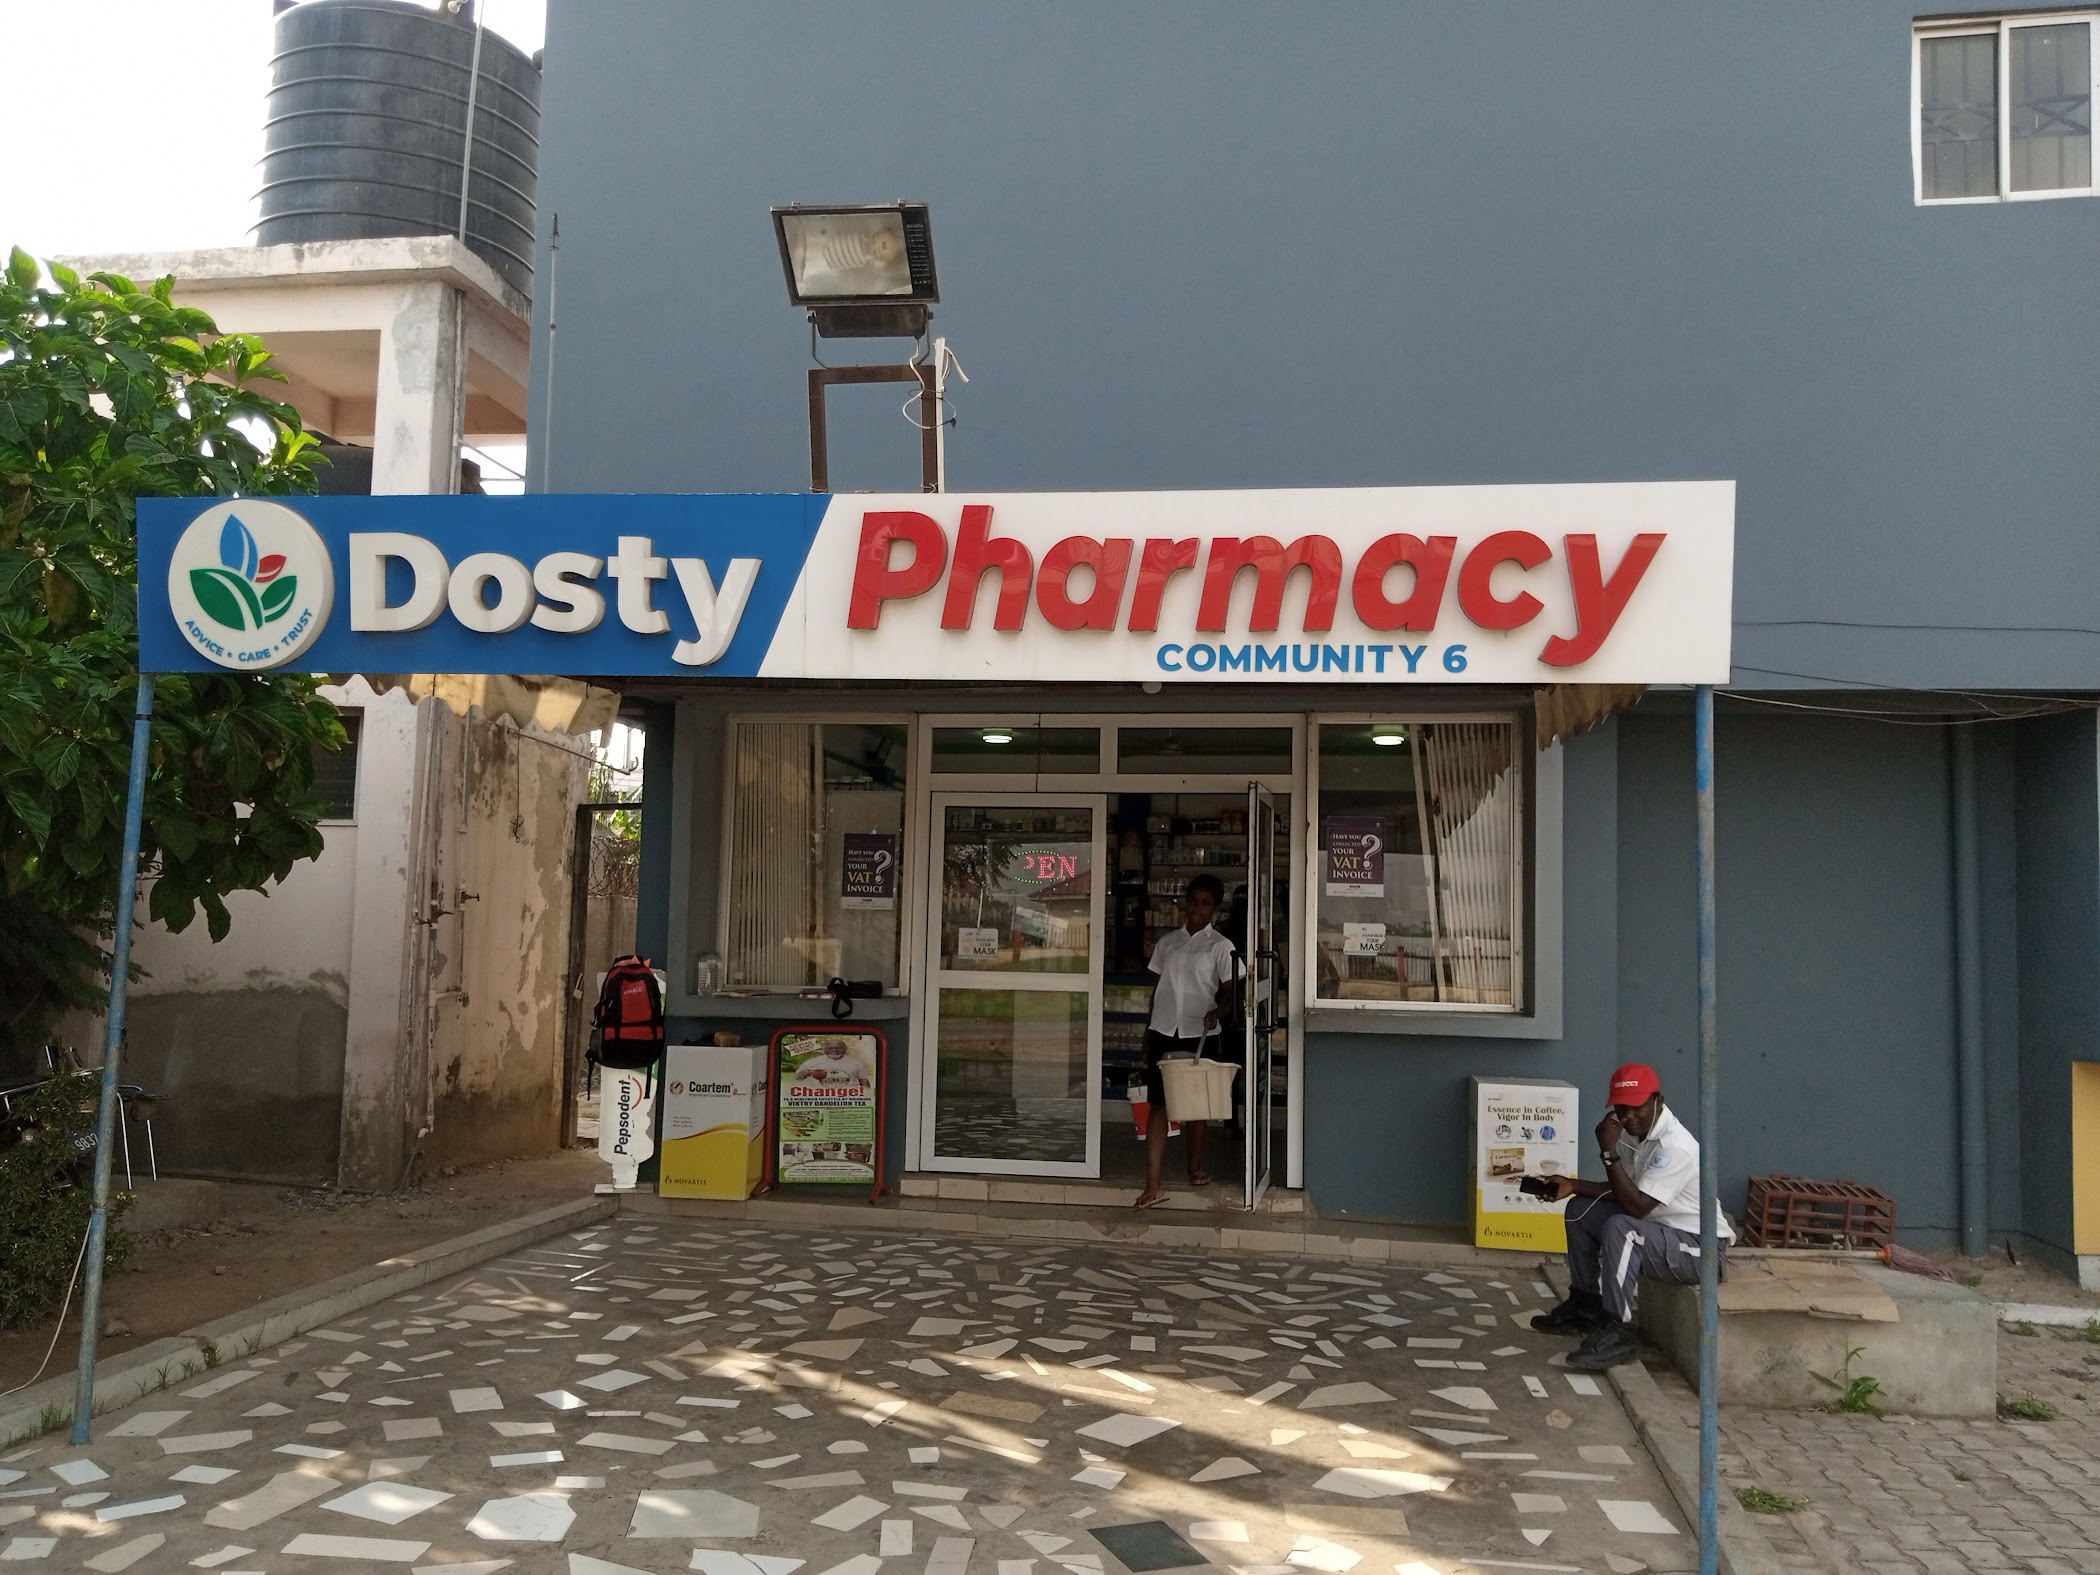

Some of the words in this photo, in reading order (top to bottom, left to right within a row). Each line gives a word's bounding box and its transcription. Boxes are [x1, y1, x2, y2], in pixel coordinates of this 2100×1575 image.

[349, 531, 762, 667] Dosty
[846, 504, 1669, 669] Pharmacy
[185, 620, 224, 657] ADVICE
[238, 648, 271, 661] CARE
[281, 608, 313, 646] TRUST
[1156, 642, 1428, 674] COMMUNITY
[1443, 644, 1468, 674] 6
[1333, 856, 1360, 869] VAT
[848, 872, 873, 883] VAT
[1333, 870, 1372, 879] INVOICE
[847, 884, 884, 892] INVOICE
[974, 947, 996, 955] MASK
[1360, 943, 1384, 951] MASK
[790, 1086, 864, 1097] Change!
[1488, 1106, 1521, 1114] Essence
[1524, 1106, 1532, 1114] In
[614, 1079, 631, 1155] Pepsodent
[1534, 1114, 1554, 1122] Body
[674, 1178, 707, 1186] NOVARTIS
[1495, 1230, 1532, 1238] NOVARTIS
